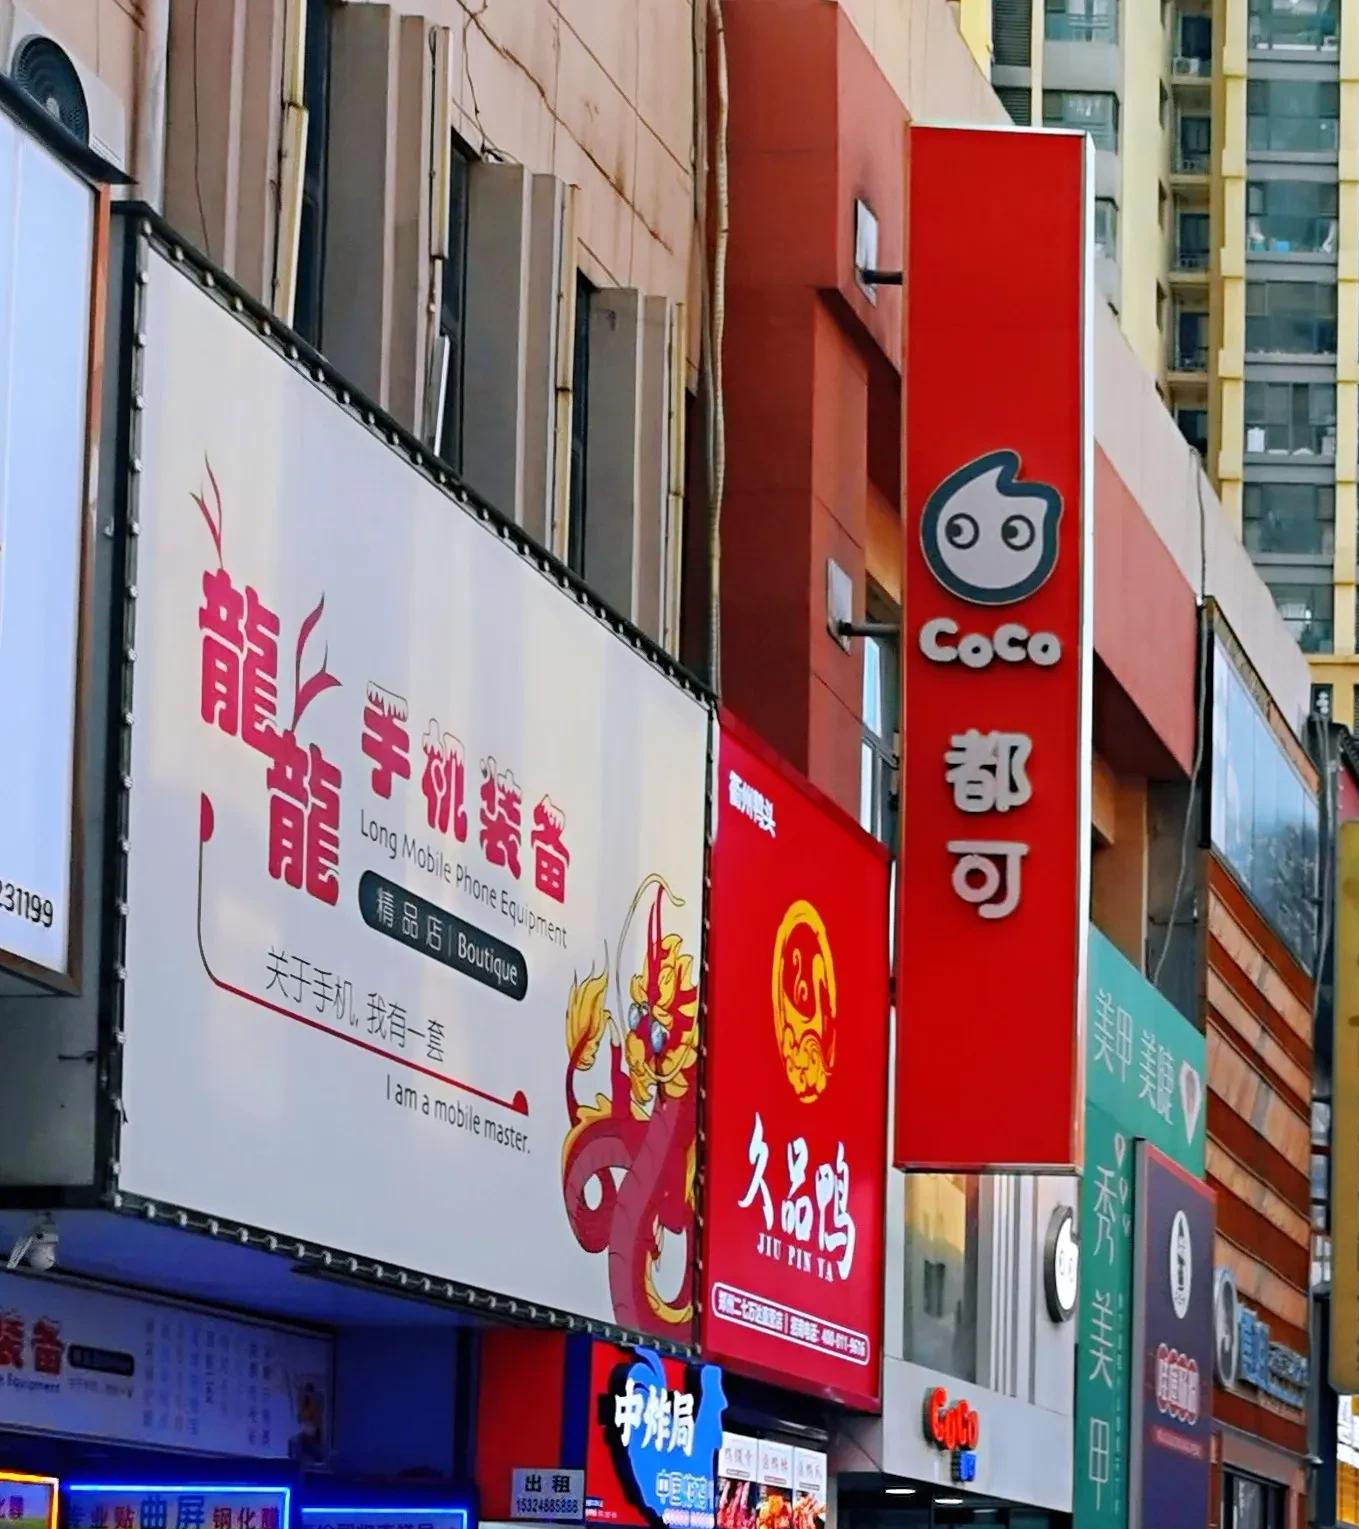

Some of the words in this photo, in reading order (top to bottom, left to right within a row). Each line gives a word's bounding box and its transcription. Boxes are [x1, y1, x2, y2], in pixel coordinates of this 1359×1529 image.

[360, 680, 571, 904] 手机装备
[945, 729, 1032, 919] 都可
[0, 880, 53, 928] 31199
[360, 808, 398, 858] Long
[402, 832, 453, 886] Mobile
[455, 862, 499, 911] Phone
[500, 890, 569, 950] Equipment
[376, 885, 444, 953] 精品店
[457, 932, 519, 987] Boutique
[394, 1080, 419, 1112] am
[434, 1095, 482, 1136] mobile
[484, 1115, 532, 1156] master.
[738, 1112, 856, 1280] 久品鸭
[757, 1233, 781, 1259] JIU
[788, 1245, 811, 1273] PIN
[818, 1256, 834, 1283] YA
[614, 1378, 696, 1457] 中炸局
[524, 1474, 571, 1493] 出租
